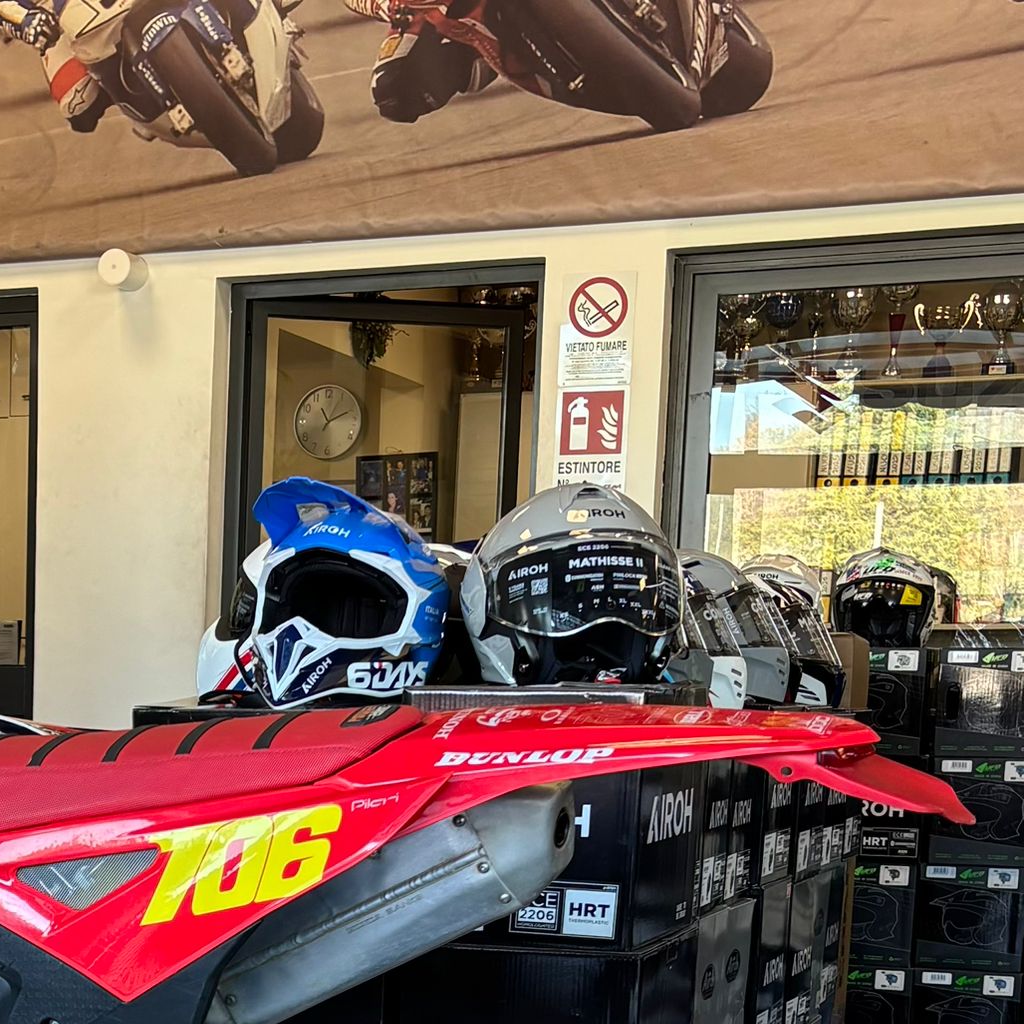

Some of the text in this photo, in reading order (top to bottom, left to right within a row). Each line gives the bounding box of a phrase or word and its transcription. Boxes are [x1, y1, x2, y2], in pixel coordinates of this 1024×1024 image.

[565, 341, 627, 352] VIETATO FUMARE
[325, 389, 333, 399] 12
[558, 461, 621, 474] ESTINTORE
[587, 508, 626, 519] IROH
[304, 522, 350, 538] AIROH
[568, 556, 644, 569] MATHISSE II
[508, 563, 549, 581] AIROH
[723, 607, 741, 635] AIROH
[303, 657, 332, 694] AIROH
[347, 661, 429, 689] 6DAYS
[434, 747, 615, 767] DUNLOP
[771, 782, 792, 808] AIROH
[647, 788, 694, 845] AIROH
[709, 799, 728, 829] AIROH
[732, 799, 752, 827] AIROH
[862, 800, 904, 817] ROH
[863, 837, 888, 846] HRT
[140, 804, 342, 926] 106
[532, 892, 557, 907] CE
[519, 909, 554, 921] 2206
[569, 902, 610, 918] HRT
[763, 953, 784, 987] AIROH
[791, 946, 812, 977] AIROH
